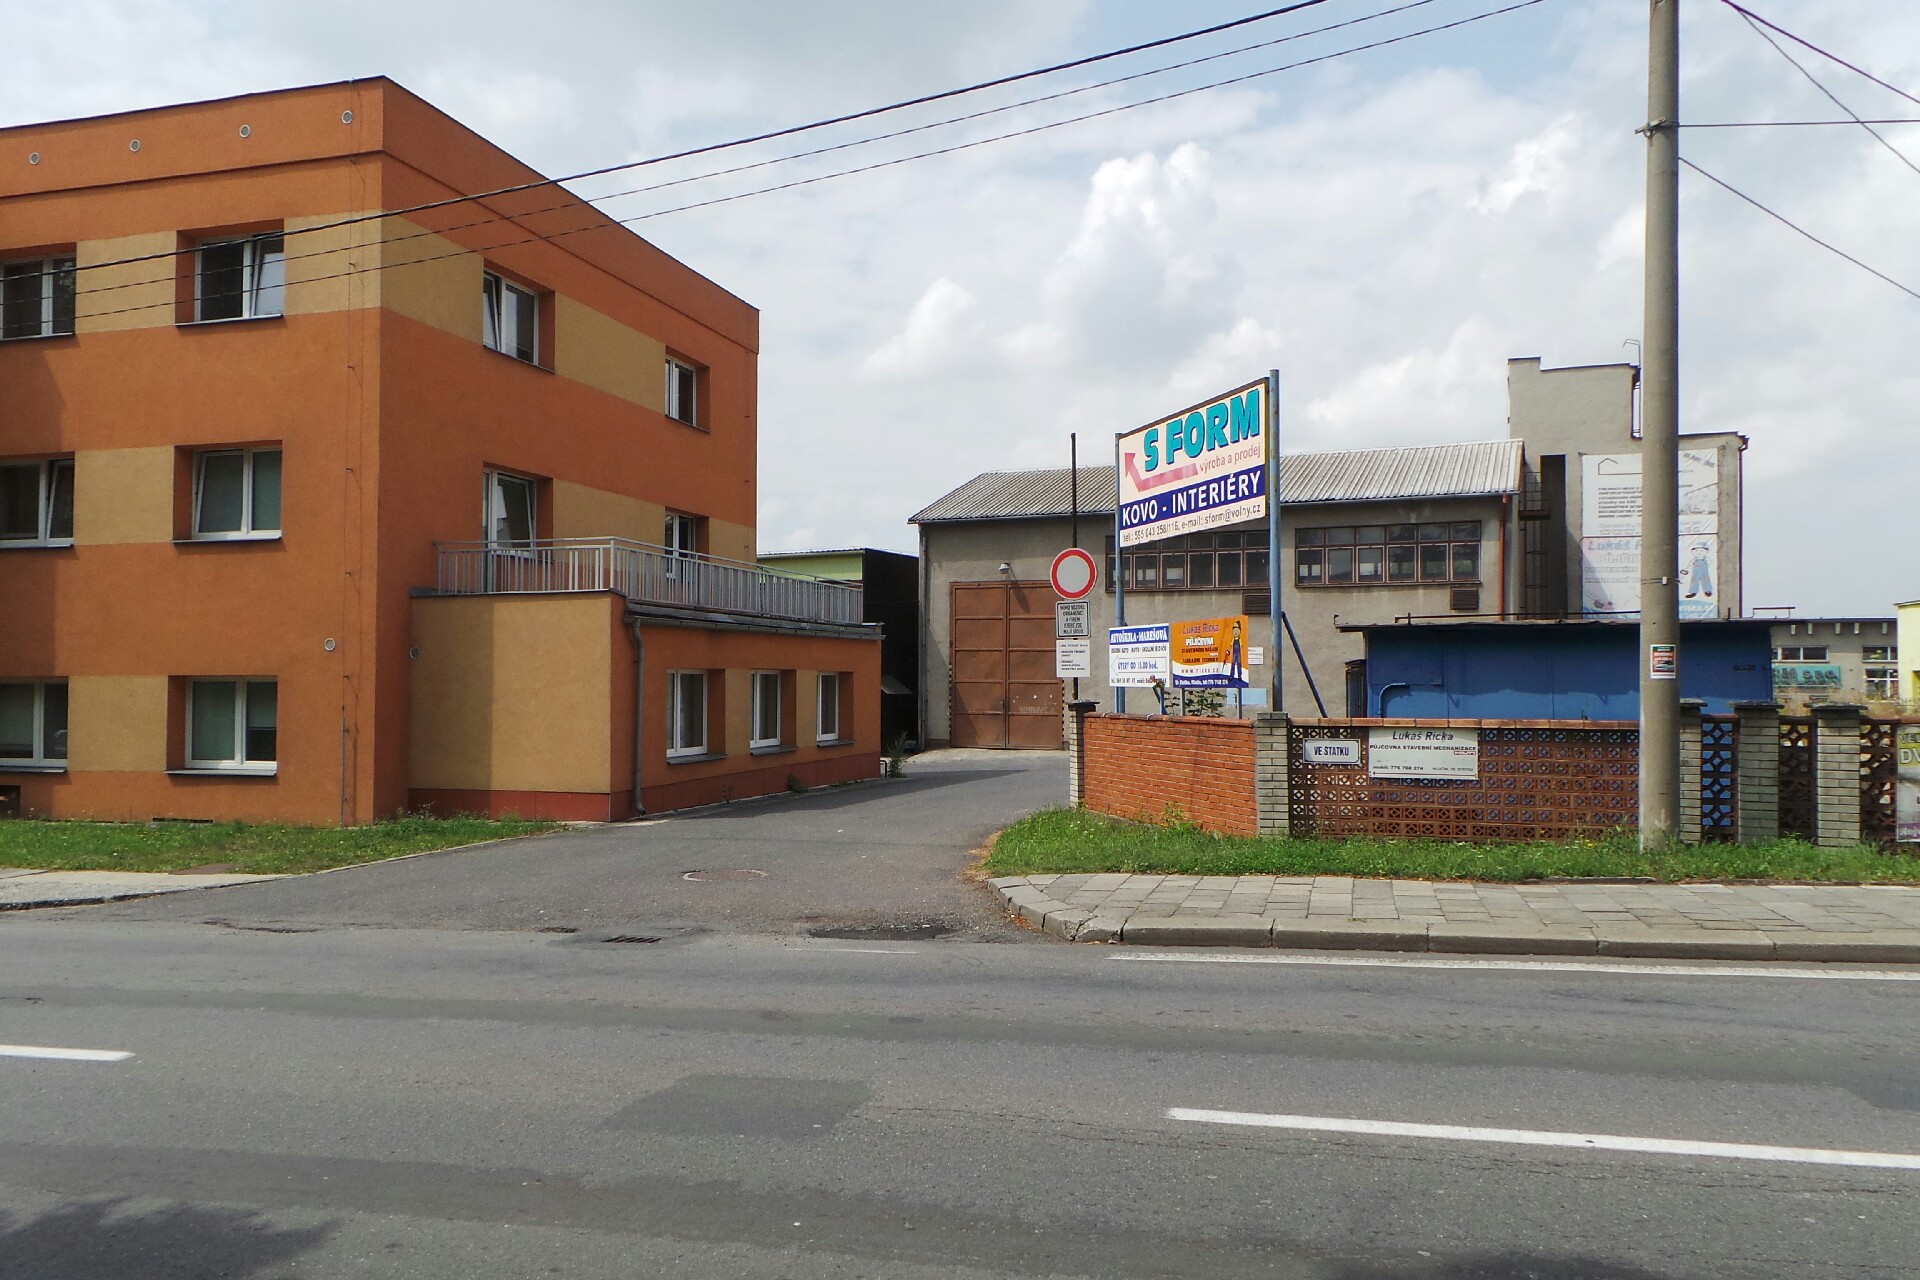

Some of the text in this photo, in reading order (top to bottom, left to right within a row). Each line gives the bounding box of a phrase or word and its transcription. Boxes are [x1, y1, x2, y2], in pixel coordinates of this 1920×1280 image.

[1144, 388, 1260, 472] S FORM
[1200, 442, 1261, 473] výroba a prodej
[1122, 499, 1158, 527] KOVO
[1172, 470, 1261, 514] INTERIÉRY
[1313, 745, 1350, 757] VE STATKU
